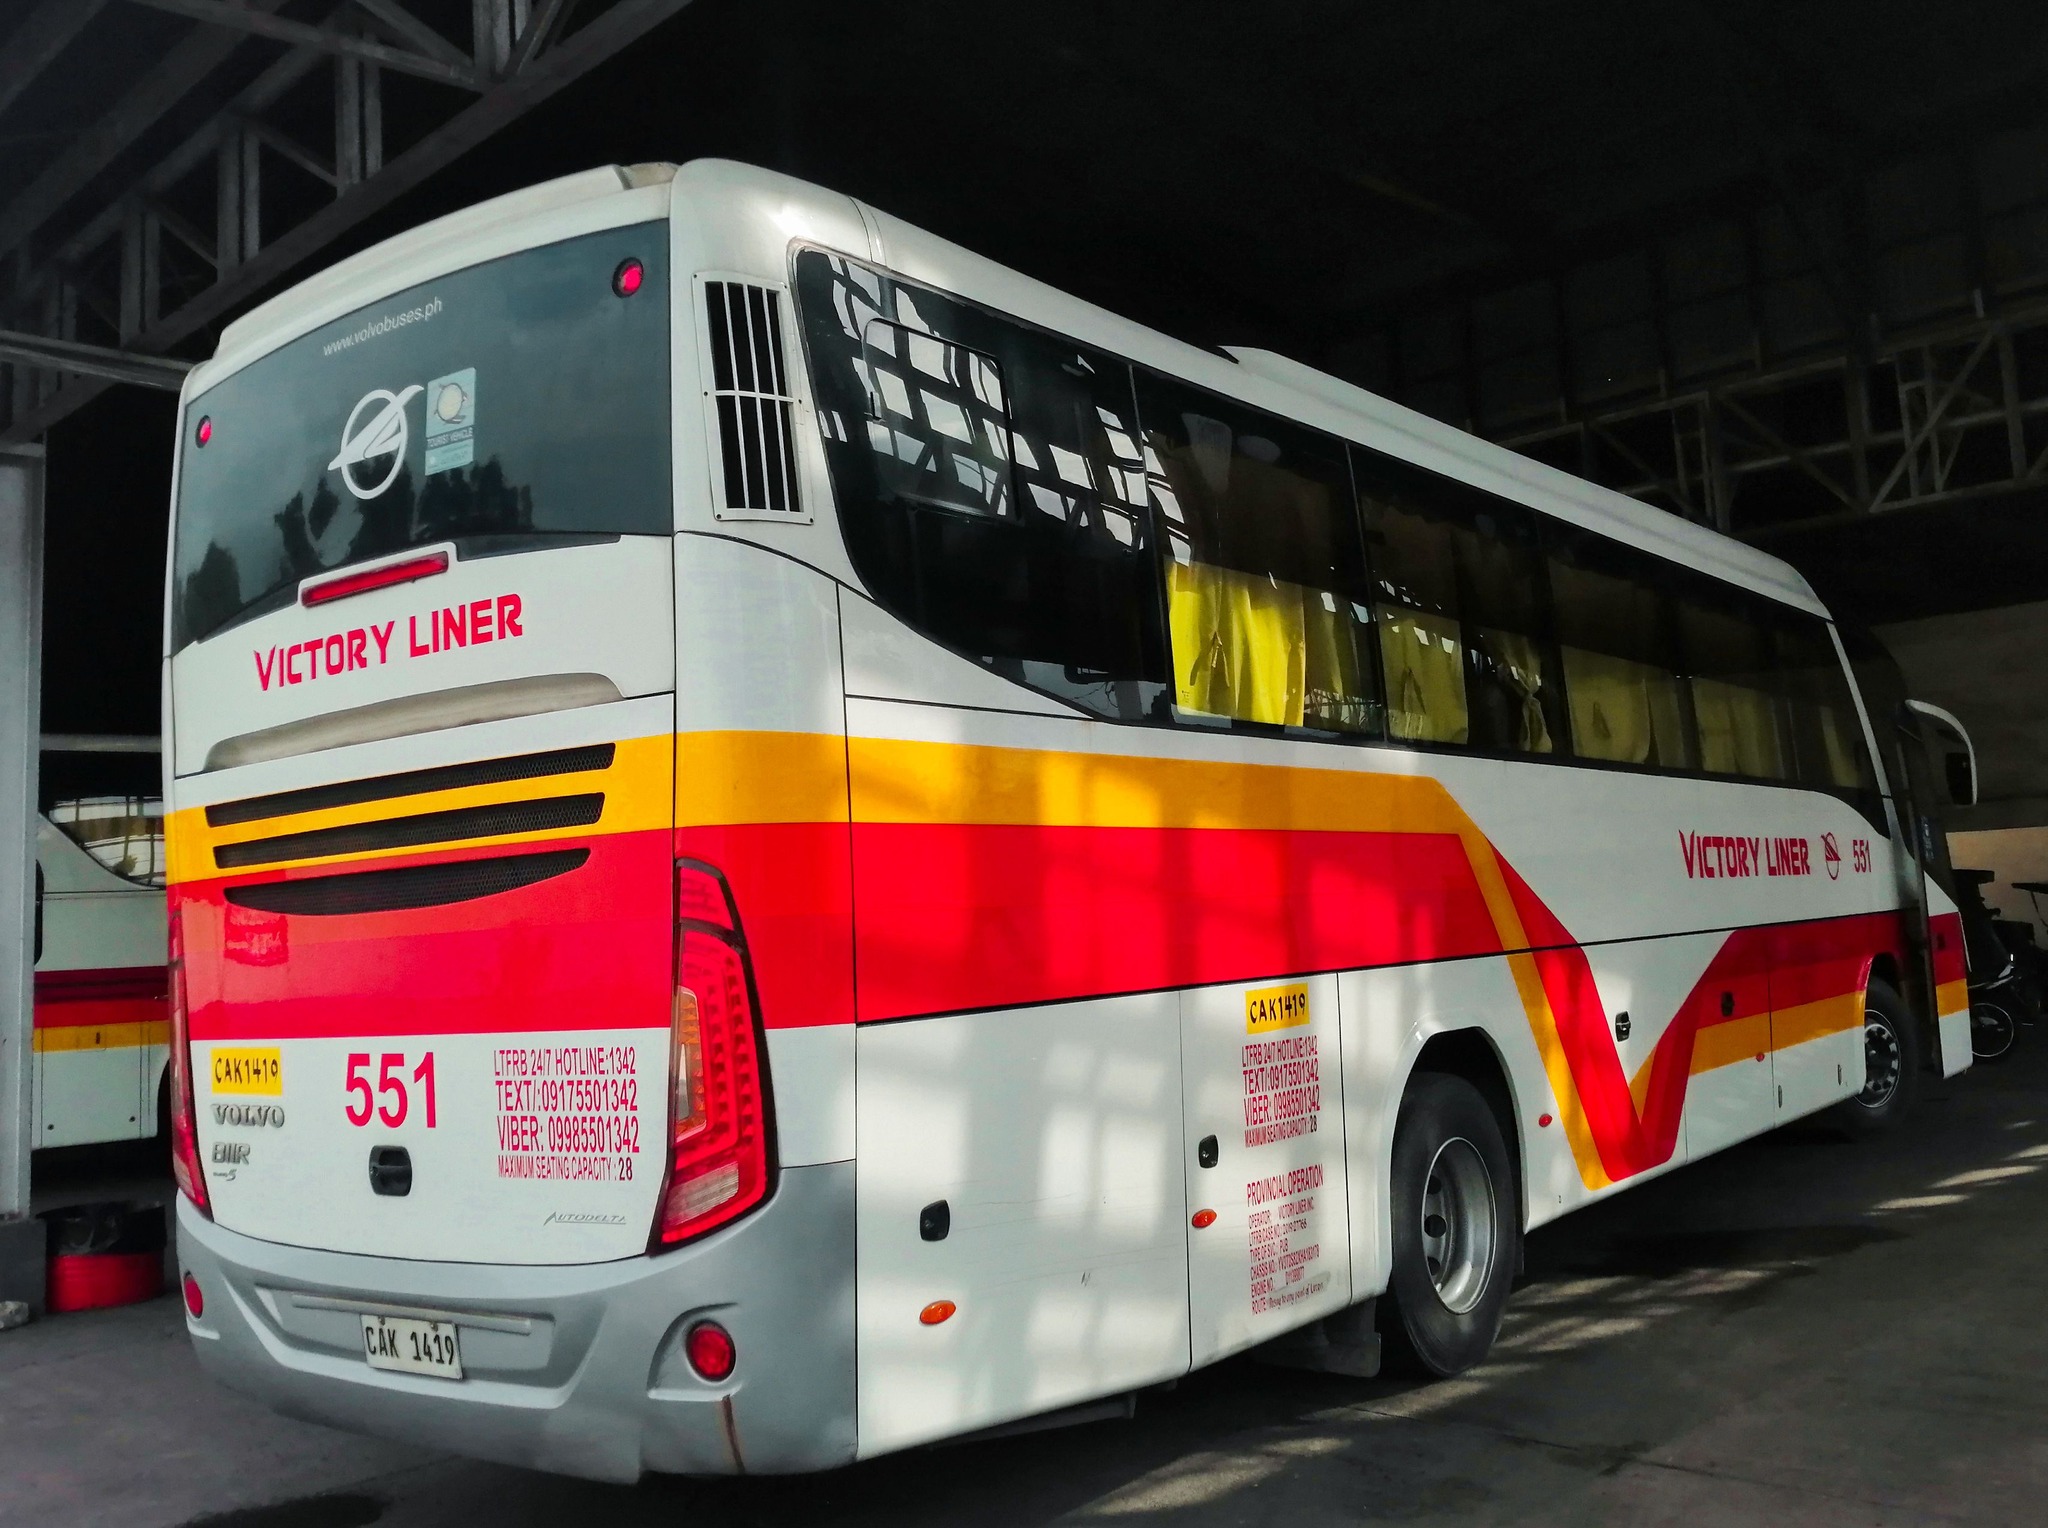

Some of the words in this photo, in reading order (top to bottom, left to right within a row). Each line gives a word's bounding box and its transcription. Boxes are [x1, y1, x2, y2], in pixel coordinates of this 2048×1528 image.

[323, 296, 443, 356] www.volvobuses.ph
[254, 620, 395, 691] VICTORY
[409, 593, 523, 658] LINER
[1679, 829, 1759, 878] VICTORY
[1765, 837, 1810, 876] LINER
[1852, 839, 1872, 873] 551
[1250, 993, 1306, 1024] CAK1419
[493, 1049, 528, 1077] LTFRB
[530, 1048, 551, 1077] 24/7
[1242, 1043, 1262, 1067] LTFRB
[1264, 1041, 1276, 1063] 24/7
[214, 1057, 278, 1085] CAK1419
[345, 1051, 437, 1129] 551
[211, 1103, 285, 1128] VOLVO
[1244, 1095, 1272, 1127] VIBER:
[1310, 1115, 1318, 1133] 28
[497, 1115, 544, 1152] VIBER:
[548, 1115, 640, 1154] 09985501342
[498, 1155, 534, 1179] MAXIMUM
[535, 1155, 570, 1180] SEATING
[618, 1157, 633, 1181] 28
[1246, 1174, 1287, 1207] PROVINCIAL
[1287, 1163, 1323, 1196] OPERATION
[365, 1326, 400, 1358] CAK
[410, 1331, 455, 1366] 1419
